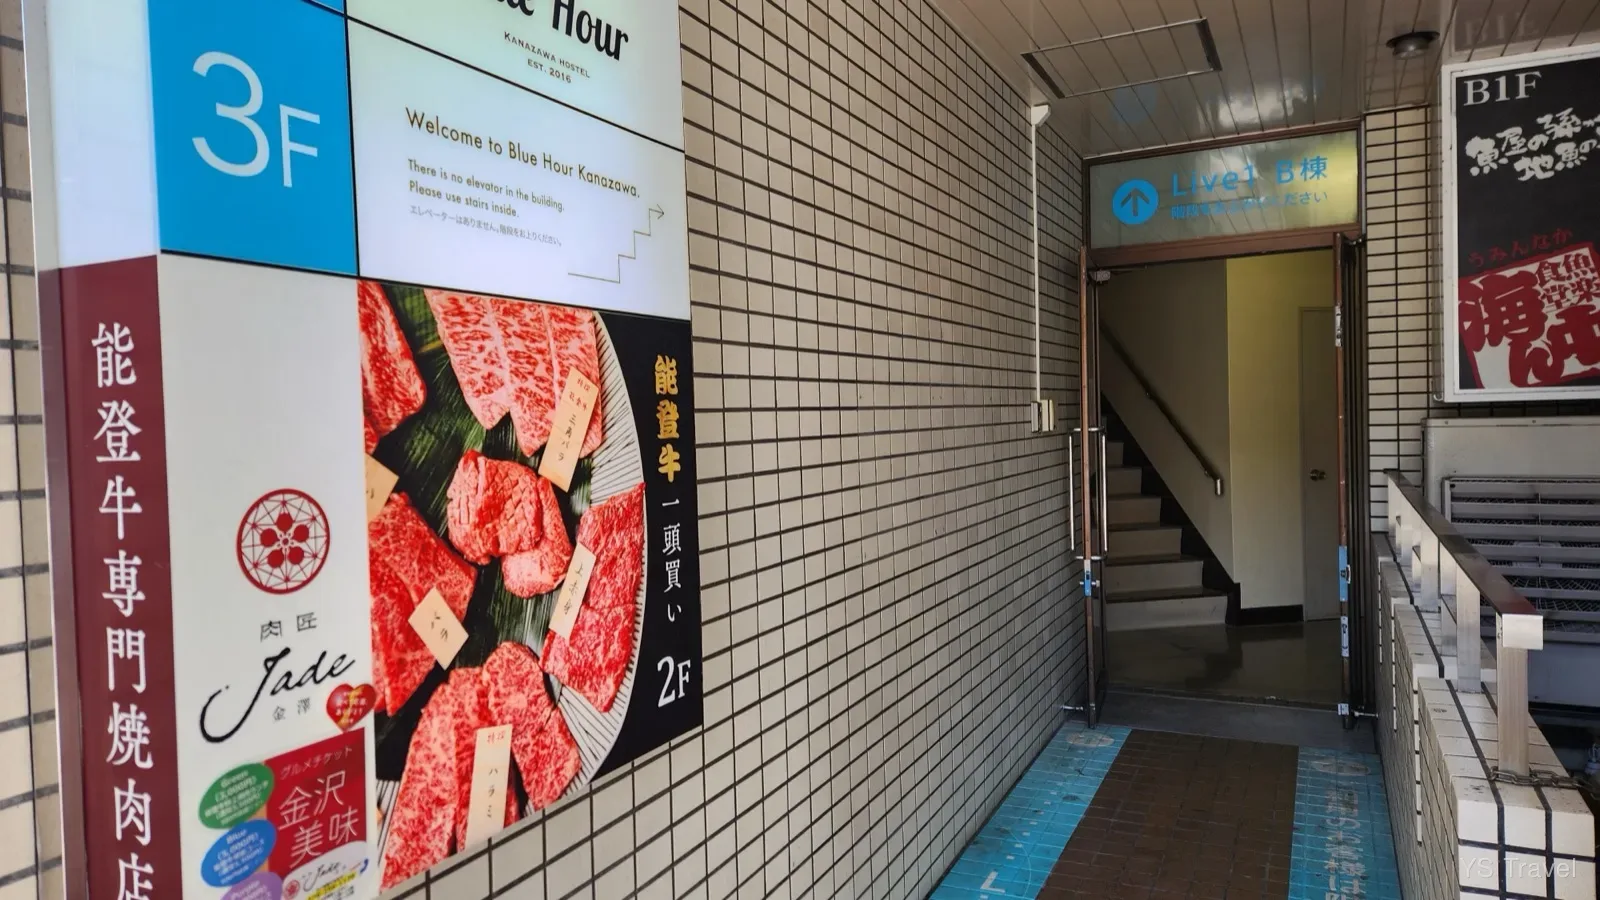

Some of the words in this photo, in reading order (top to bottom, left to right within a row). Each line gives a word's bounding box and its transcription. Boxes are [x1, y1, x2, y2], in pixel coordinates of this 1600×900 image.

[504, 31, 557, 62] KANAZAWA
[559, 57, 591, 79] HOSTEL
[552, 0, 629, 61] Hour
[527, 58, 546, 73] EST.
[549, 66, 572, 84] 2016
[1463, 70, 1542, 106] B1F
[192, 50, 321, 188] 3F
[405, 107, 483, 149] Welcome
[488, 137, 503, 156] to
[508, 141, 538, 166] Blue
[543, 152, 573, 177] Hour
[578, 164, 640, 198] Kanazawa.
[407, 158, 437, 177] There
[440, 167, 448, 180] is
[451, 173, 463, 184] no
[466, 174, 503, 194] elevator
[505, 185, 514, 197] in
[516, 188, 529, 201] the
[531, 191, 565, 213] building.
[409, 180, 442, 199] Please
[445, 193, 462, 204] use
[465, 196, 489, 210] stairs
[491, 201, 519, 218] inside.
[654, 354, 682, 483] 能登牛
[661, 498, 682, 622] 一頭買い
[91, 322, 155, 900] 能登牛専門焼肉店
[260, 611, 317, 642] 肉匠
[200, 646, 356, 743] Jade
[657, 655, 691, 708] 2F
[278, 770, 346, 831] 金沢
[289, 805, 360, 869] 美味
